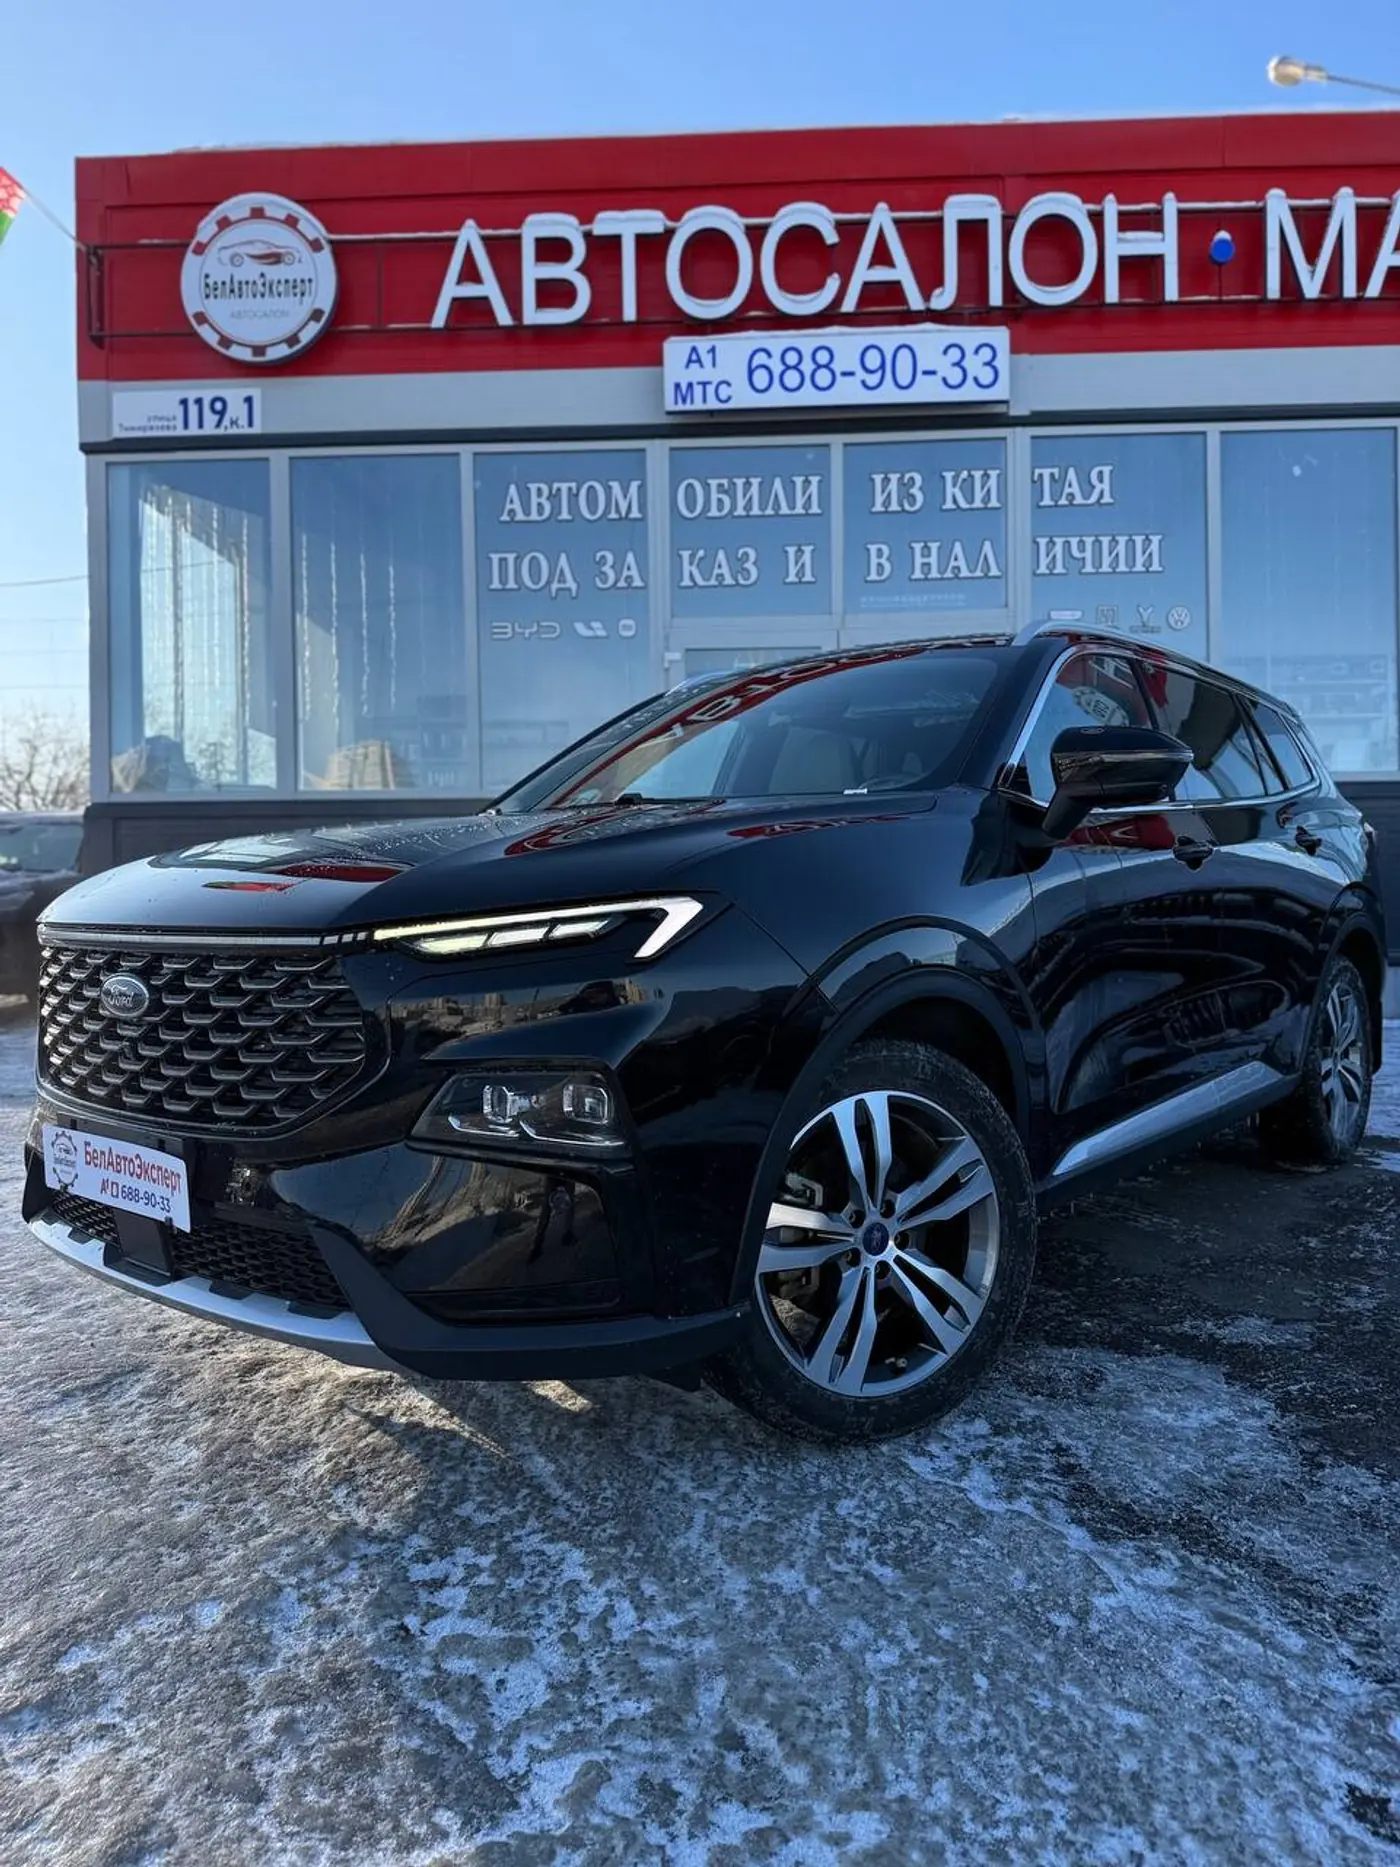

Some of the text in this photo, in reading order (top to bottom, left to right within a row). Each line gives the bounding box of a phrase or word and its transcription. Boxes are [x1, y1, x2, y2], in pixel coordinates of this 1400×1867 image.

[430, 192, 1179, 328] АВТОСАЛОН
[204, 272, 313, 305] БелАвтоЭксперт
[684, 345, 717, 369] A1
[747, 343, 999, 394] 688-90-33
[673, 380, 733, 405] МТС
[869, 471, 924, 514] ИЗ
[488, 551, 579, 600] ПОД
[784, 545, 816, 584] И
[864, 543, 892, 583] В
[491, 622, 561, 640] BYD
[84, 1140, 181, 1196] БелАвтоЭксперт
[121, 1184, 172, 1214] 688-90-33
